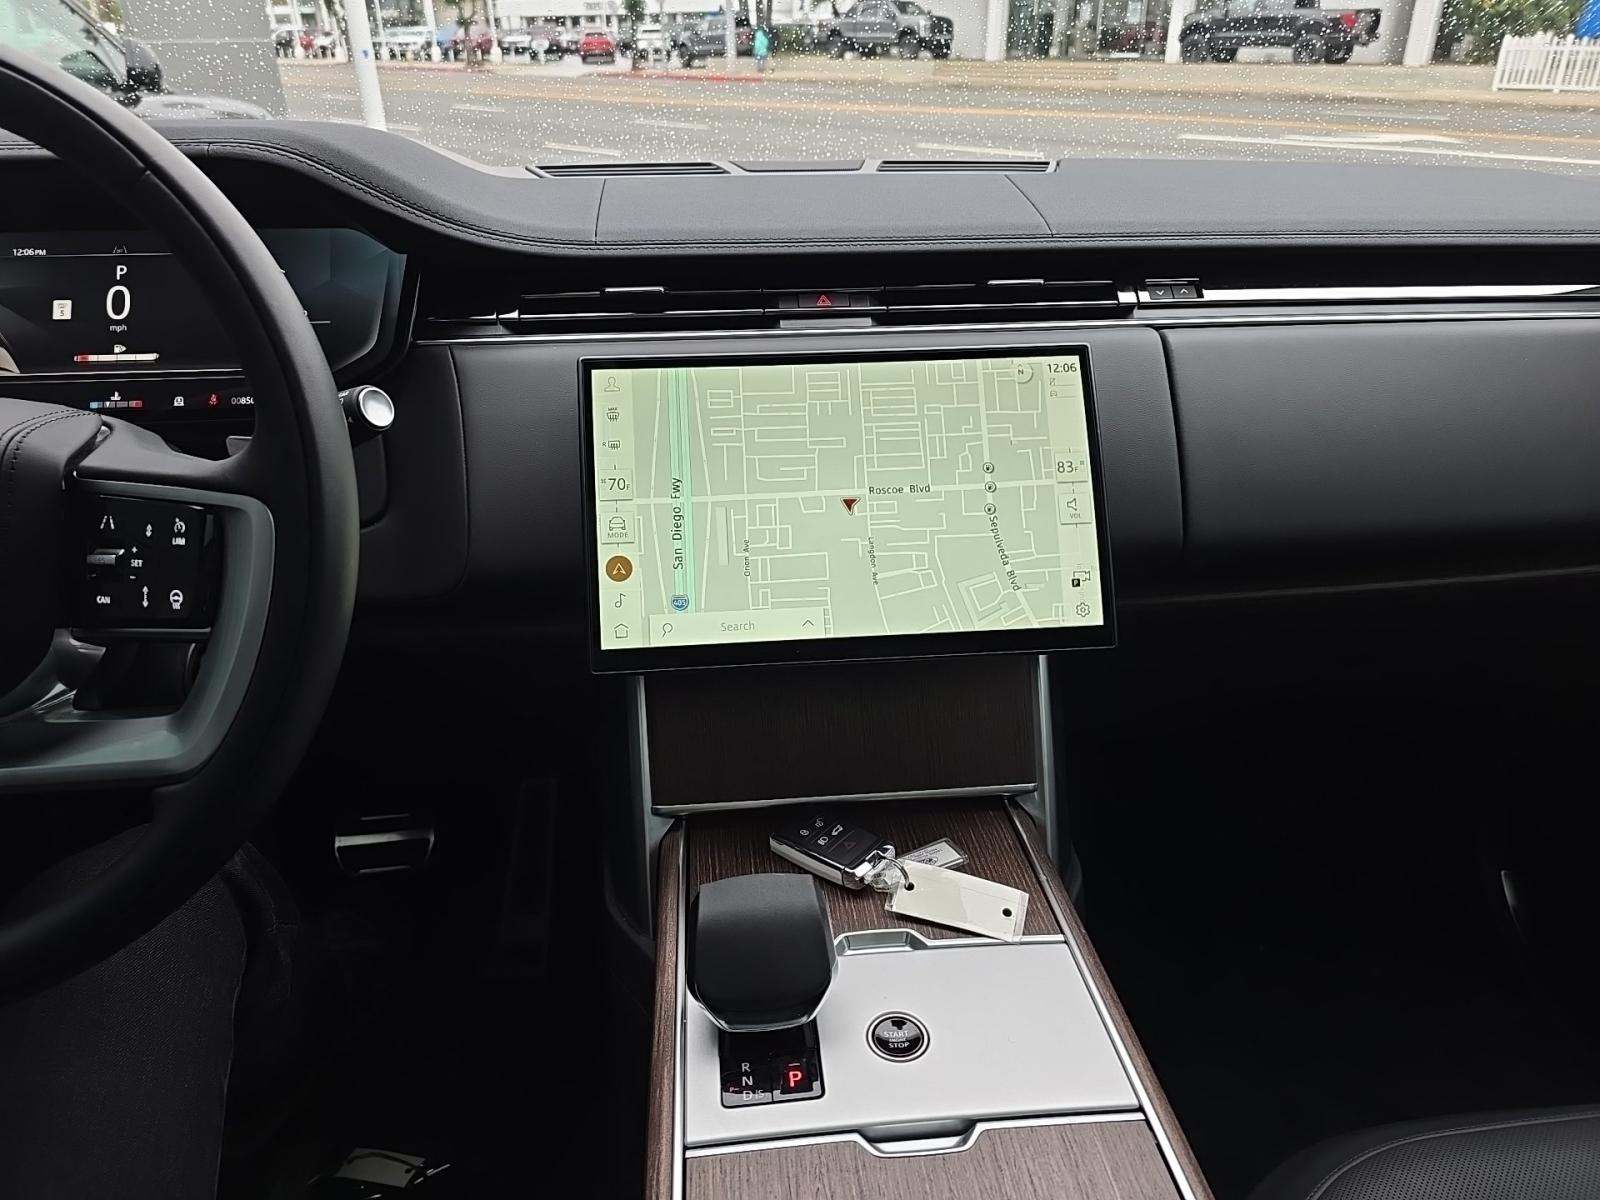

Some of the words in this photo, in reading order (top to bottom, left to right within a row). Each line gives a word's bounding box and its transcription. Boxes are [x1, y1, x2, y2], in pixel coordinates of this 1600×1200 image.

[116, 265, 128, 280] P
[106, 285, 131, 320] 0
[109, 324, 128, 332] mph
[1047, 362, 1077, 373] 12:06
[670, 477, 683, 500] Fwy
[868, 485, 904, 496] Roscoe
[909, 484, 931, 495] Blvd
[670, 506, 685, 541] Diego
[742, 539, 750, 553] Ave
[672, 548, 684, 570] San
[989, 515, 1010, 566] Sepulveda
[1006, 569, 1022, 592] Blvd
[129, 559, 144, 568] SET
[871, 572, 879, 586] Ave
[96, 595, 111, 604] CAN
[720, 620, 756, 632] Search
[883, 1030, 909, 1038] START
[888, 1041, 911, 1049] STOP
[741, 1062, 751, 1073] R
[742, 1075, 753, 1087] N
[788, 1071, 802, 1088] P
